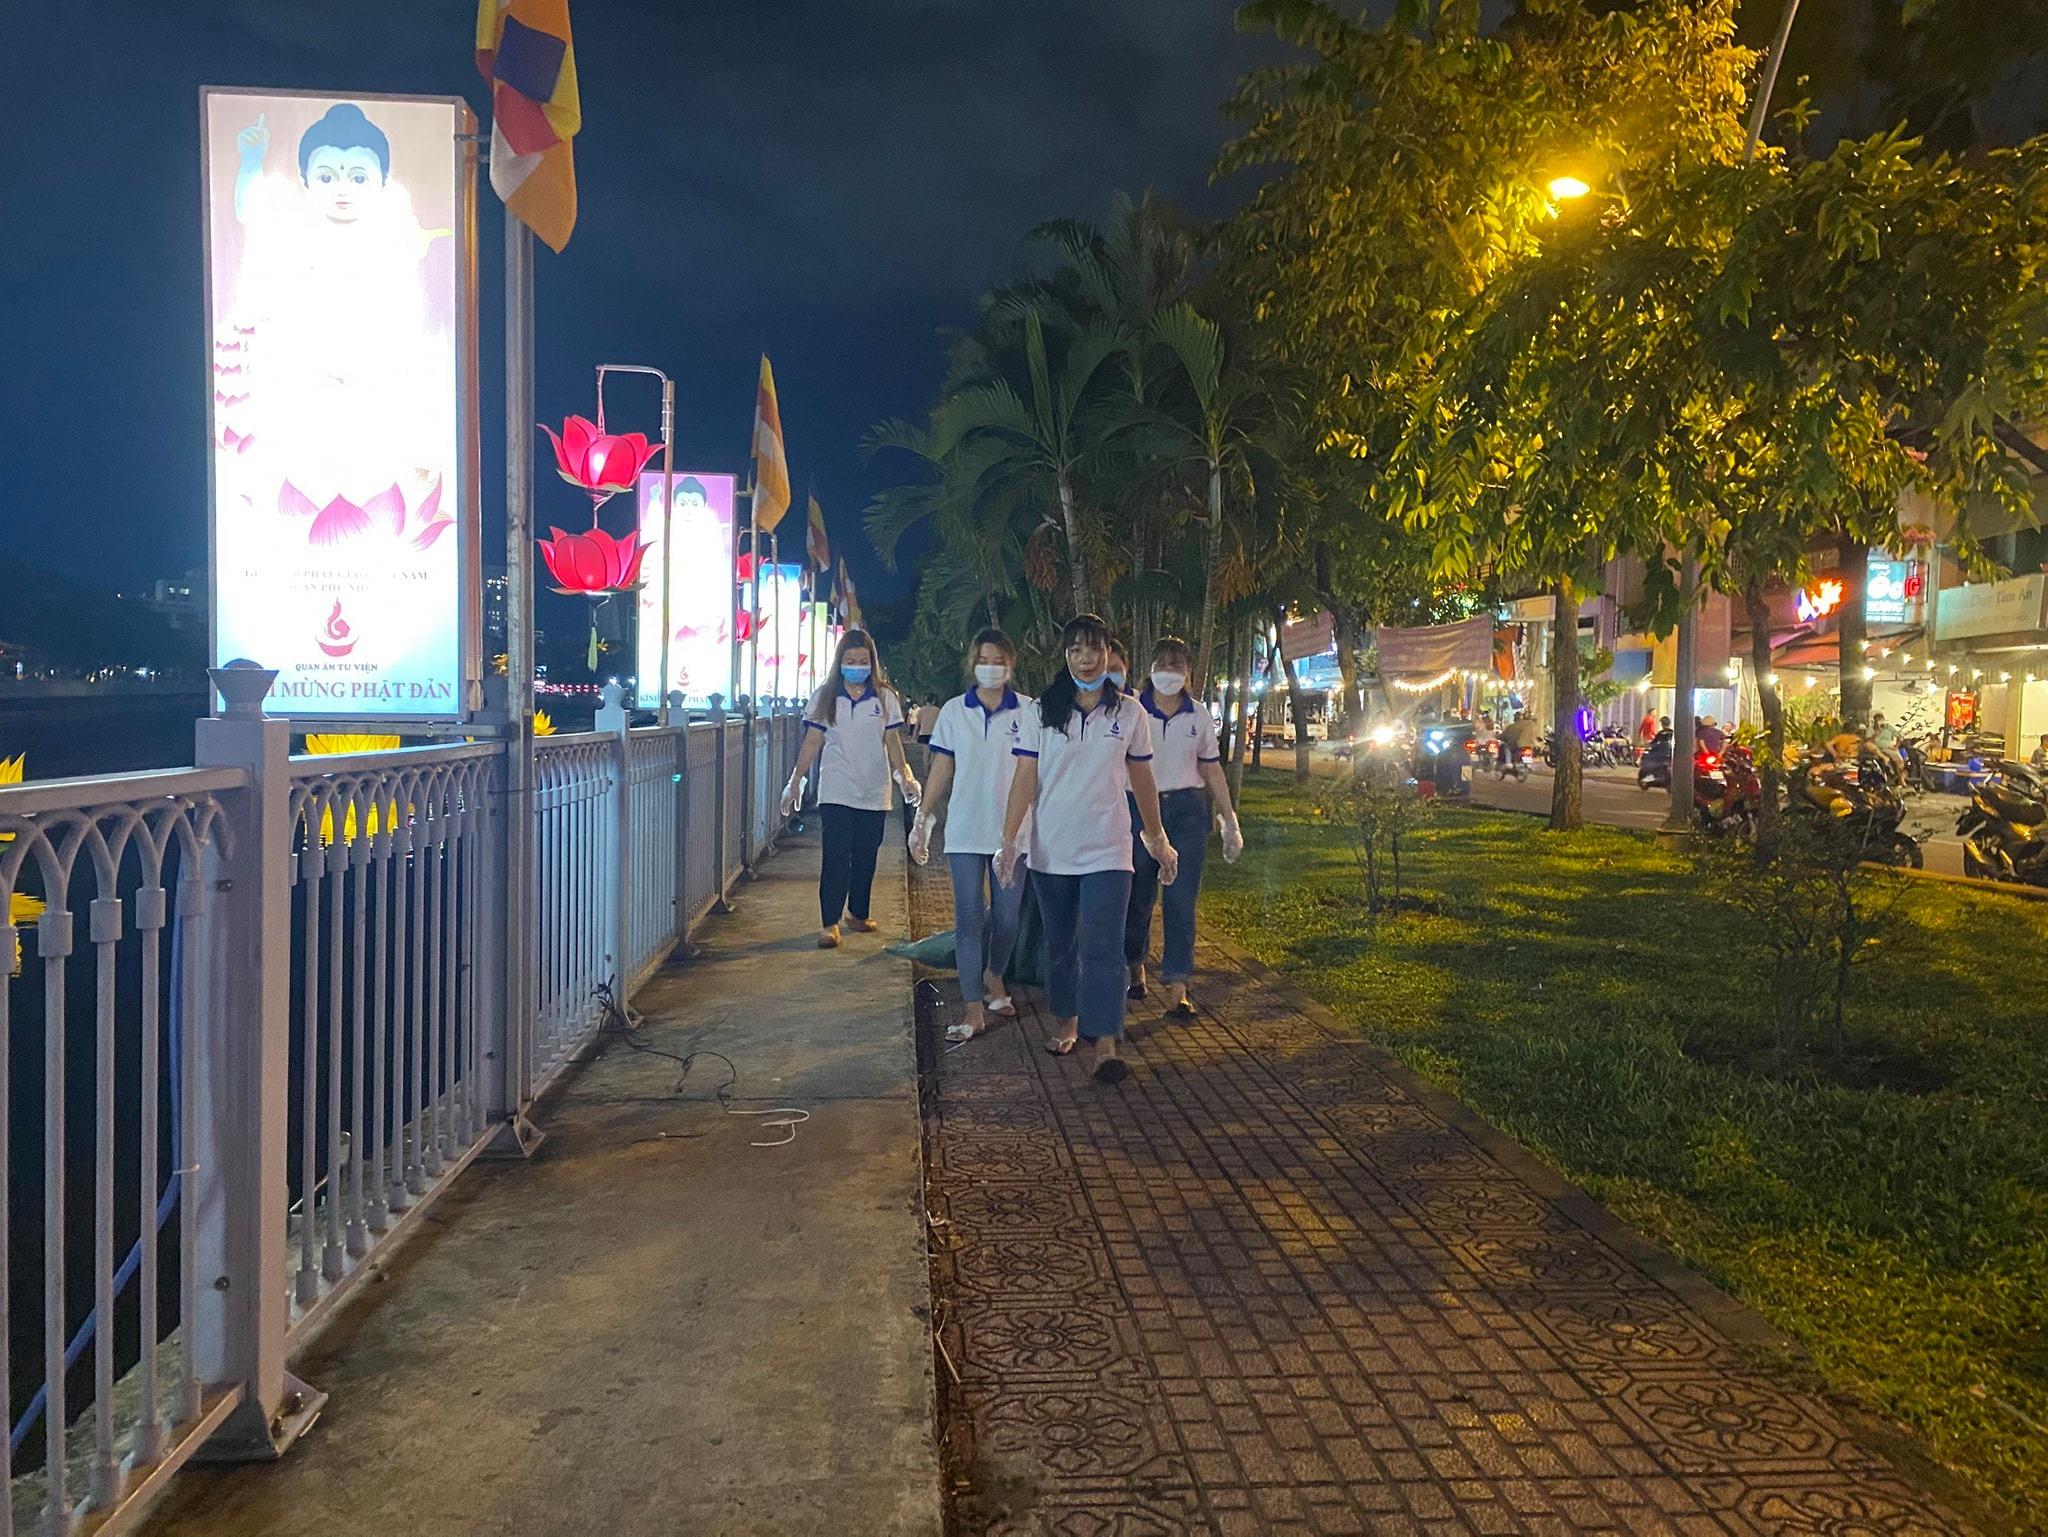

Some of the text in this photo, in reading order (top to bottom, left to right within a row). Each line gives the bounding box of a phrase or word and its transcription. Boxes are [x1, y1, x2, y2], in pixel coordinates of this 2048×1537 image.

[295, 663, 320, 672] QUAN
[338, 663, 351, 671] TU
[354, 661, 378, 674] VIỆN
[281, 677, 346, 698] MỪNG
[351, 679, 406, 702] PHẬT
[409, 678, 452, 699] ĐẢN
